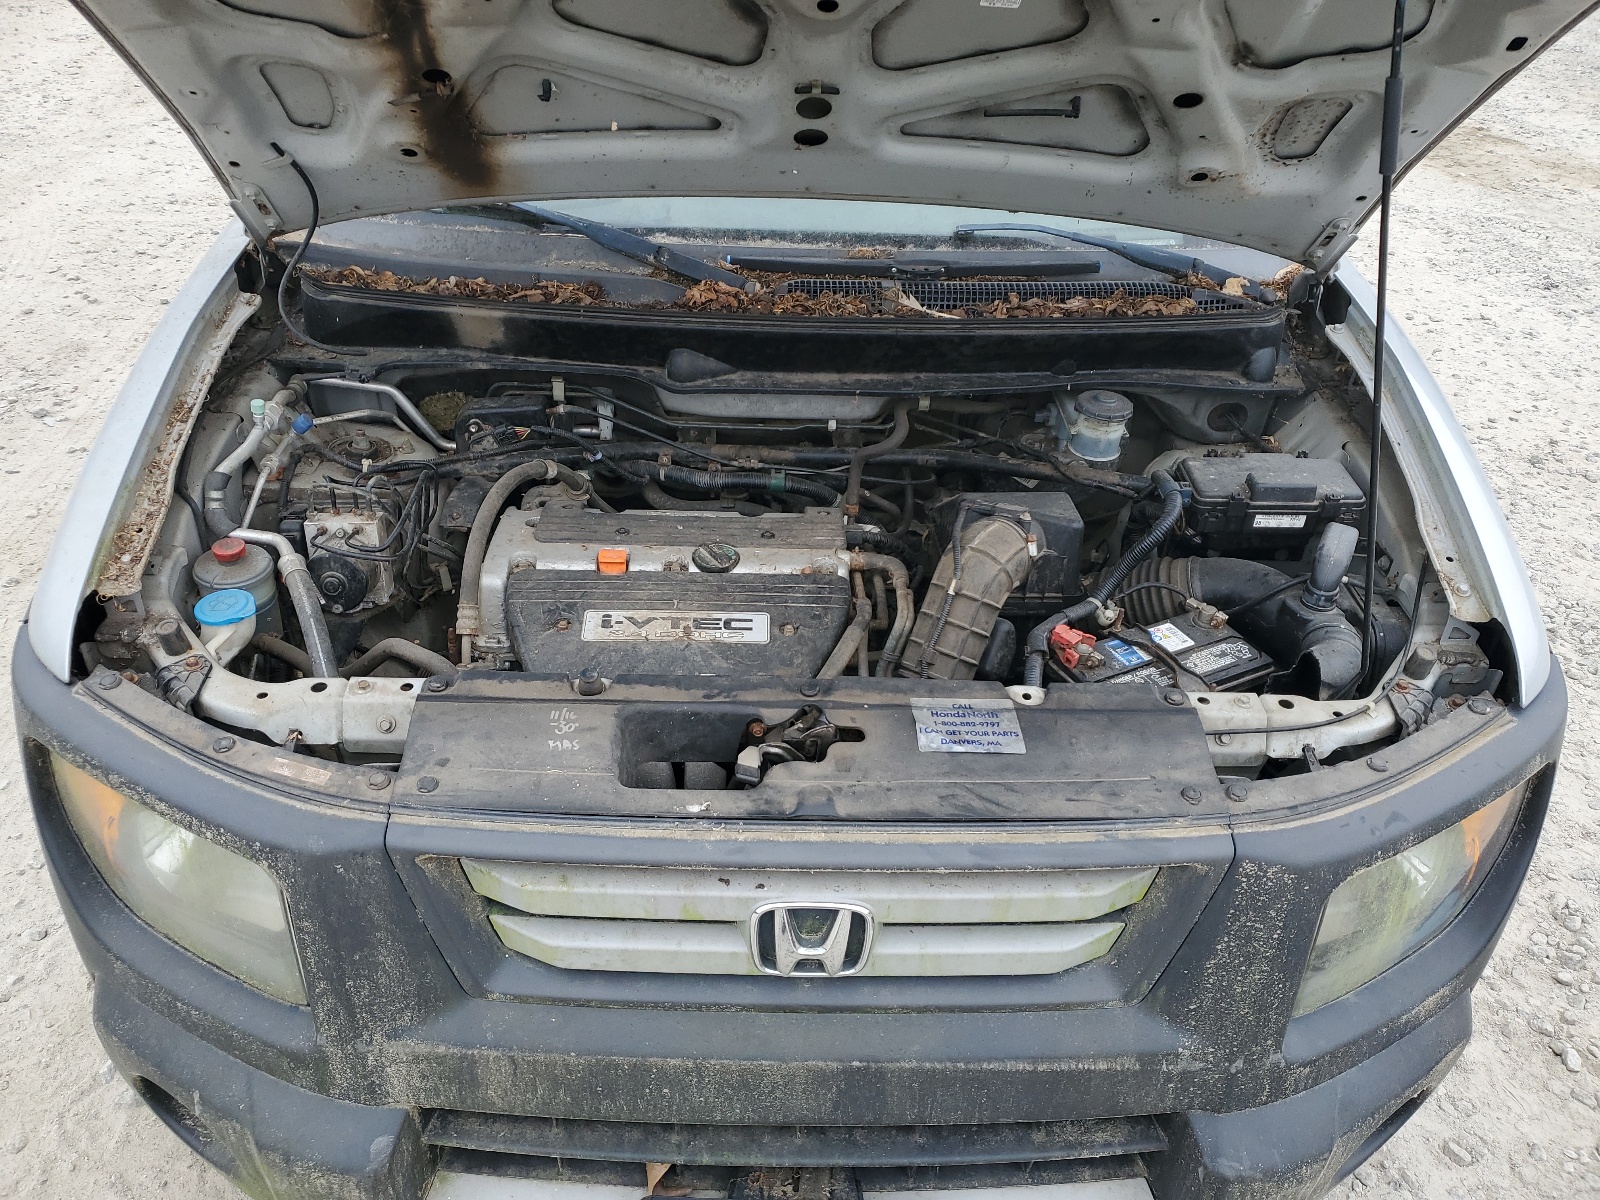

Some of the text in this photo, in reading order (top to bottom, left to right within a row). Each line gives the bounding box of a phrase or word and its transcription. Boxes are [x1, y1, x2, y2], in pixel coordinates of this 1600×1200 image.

[930, 710, 999, 719] Honda North
[933, 720, 1000, 728] 1-800-882-9797
[940, 738, 985, 747] DANVERS,
